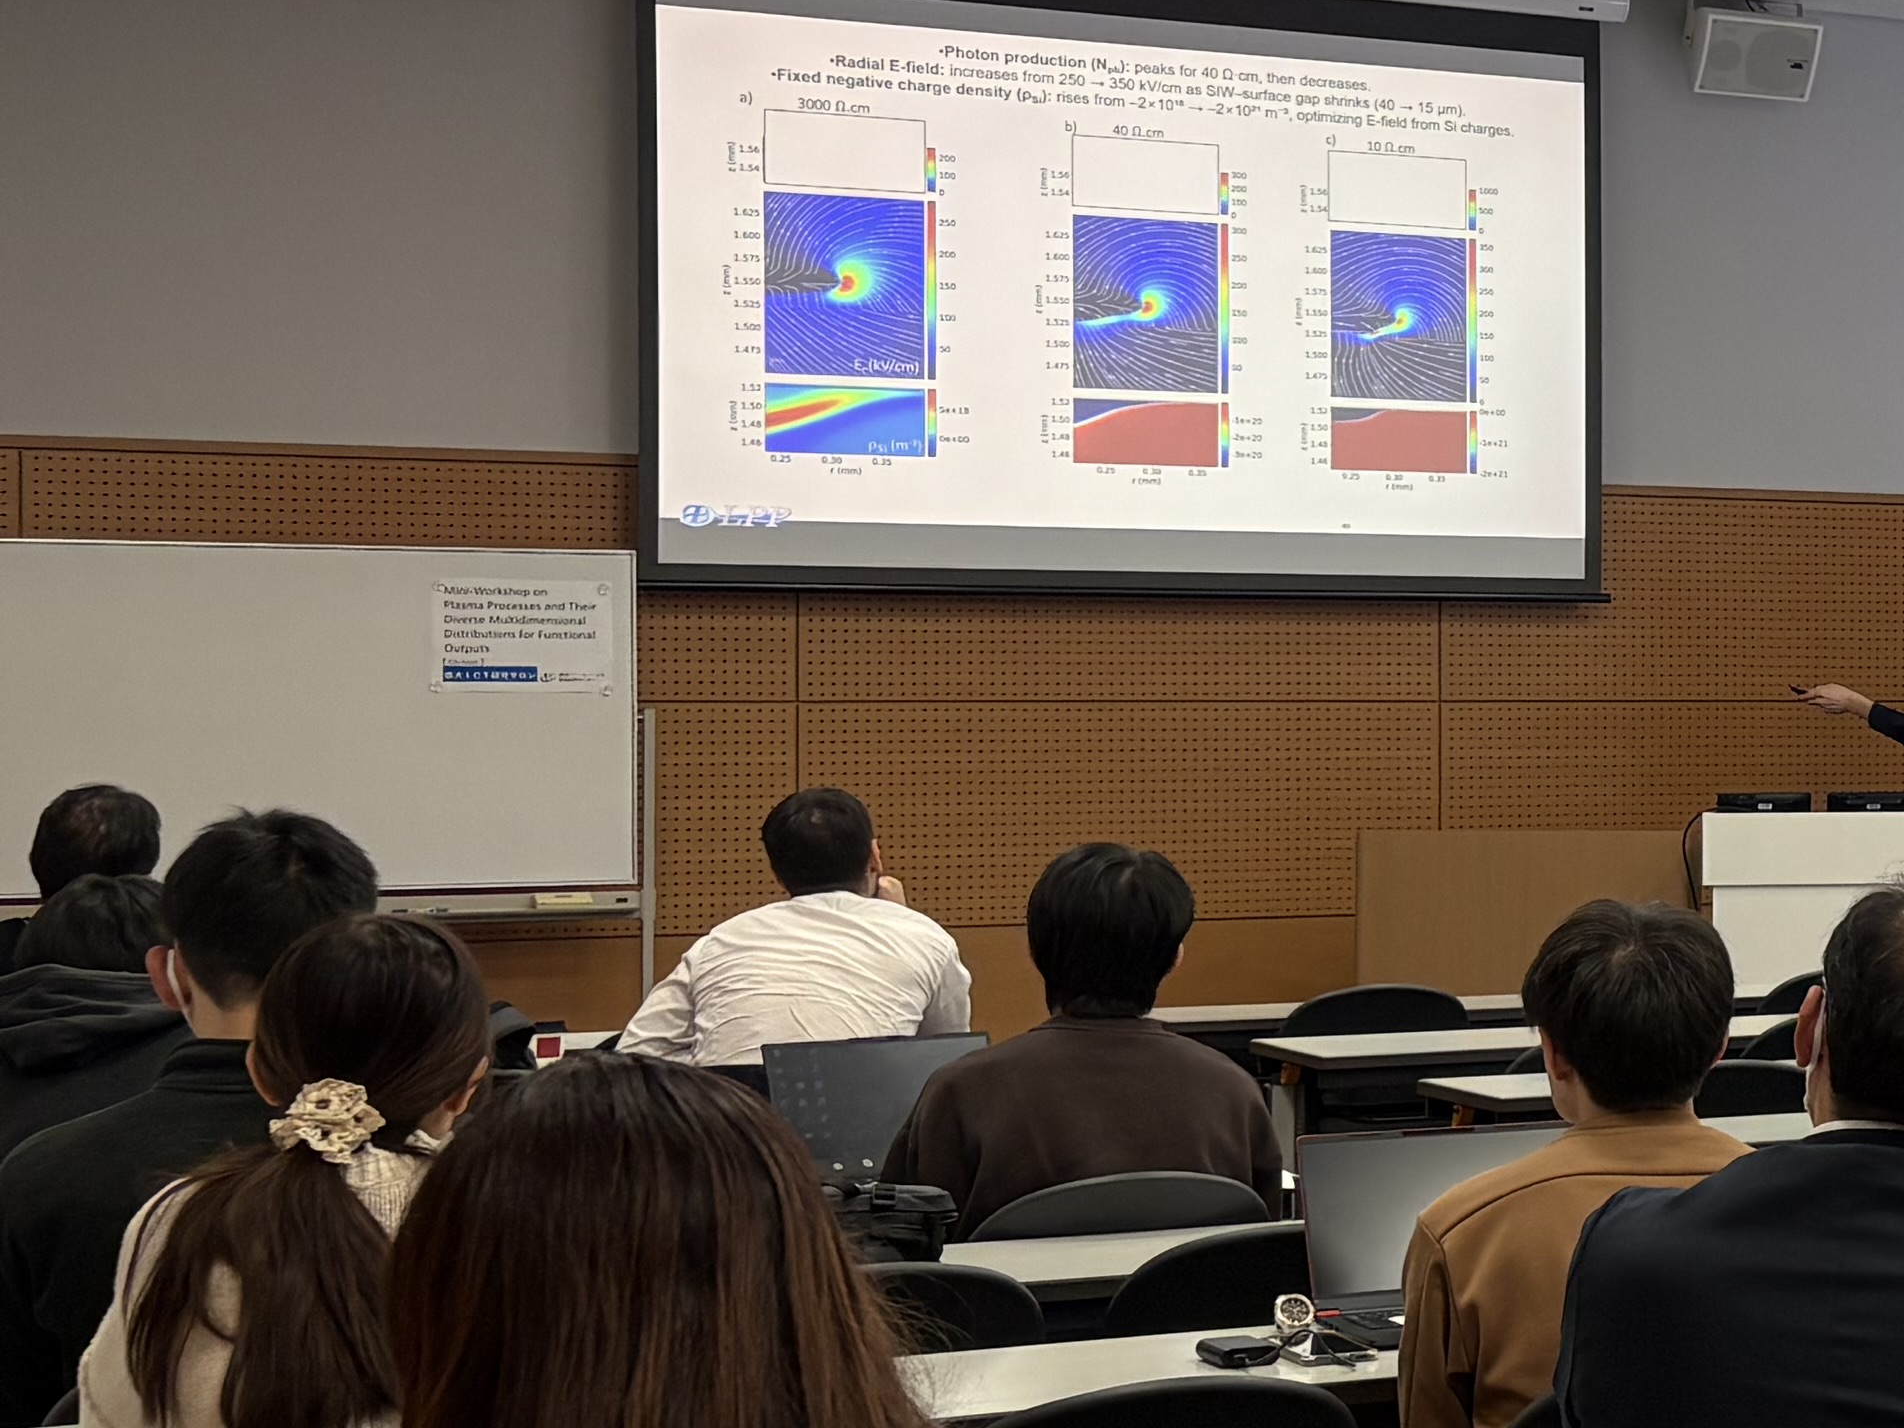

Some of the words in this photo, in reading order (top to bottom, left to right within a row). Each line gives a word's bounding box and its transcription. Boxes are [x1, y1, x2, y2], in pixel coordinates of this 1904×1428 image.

[944, 45, 999, 62] Photon
[1004, 52, 1087, 68] production
[1134, 62, 1176, 75] peaks
[1179, 64, 1197, 77] for
[1201, 66, 1218, 79] 40
[1267, 72, 1296, 85] then
[1299, 75, 1371, 92] decreases.
[835, 55, 884, 71] Radial
[888, 59, 945, 76] E-field:
[949, 63, 1019, 82] increases
[1022, 70, 1055, 84] from
[1058, 73, 1086, 86] 250
[1108, 77, 1135, 91] 350
[1139, 79, 1182, 94] kV/cm
[1186, 85, 1202, 96] as
[1295, 93, 1320, 107] gap
[1323, 94, 1370, 109] shrinks
[1373, 98, 1395, 112] (40
[1418, 101, 1434, 114] 15
[739, 91, 753, 105] a)
[777, 67, 821, 83] Fixed
[826, 74, 893, 90] negative
[897, 79, 951, 96] charge
[955, 82, 1012, 101] density
[1056, 90, 1090, 105] rises
[1094, 93, 1125, 108] from
[1296, 109, 1363, 128] optimizing
[1366, 114, 1407, 129] E-field
[1411, 117, 1440, 131] from
[1444, 120, 1457, 132] Si
[1460, 123, 1515, 138] charges.
[797, 97, 831, 111] 3000
[1065, 120, 1077, 134] b)
[1112, 125, 1129, 136] 40
[1325, 134, 1337, 147] c)
[1367, 140, 1381, 152] 10
[939, 154, 956, 163] 200
[939, 171, 956, 180] 100
[1478, 187, 1499, 196] 1000
[733, 208, 760, 217] 1.625
[939, 219, 956, 227] 250
[733, 230, 761, 240] 1.600
[1045, 230, 1070, 240] 1.625
[733, 253, 761, 262] 1.575
[939, 250, 956, 259] 200
[1045, 252, 1070, 261] 1.600
[733, 276, 761, 286] 1.550
[1045, 274, 1070, 283] 1.575
[939, 282, 956, 291] 150
[733, 299, 761, 309] 1.525
[1045, 296, 1070, 305] 1.550
[939, 313, 956, 322] 100
[734, 322, 761, 331] 1.500
[1045, 339, 1070, 349] 1.500
[1305, 350, 1328, 360] 1.500
[1479, 354, 1495, 363] 100
[770, 454, 791, 463] 0.25
[821, 456, 843, 465] 0.30
[871, 457, 892, 466] 0.35
[717, 504, 792, 528] LPP
[544, 602, 566, 610] and
[569, 601, 597, 611] Their
[518, 629, 535, 639] for
